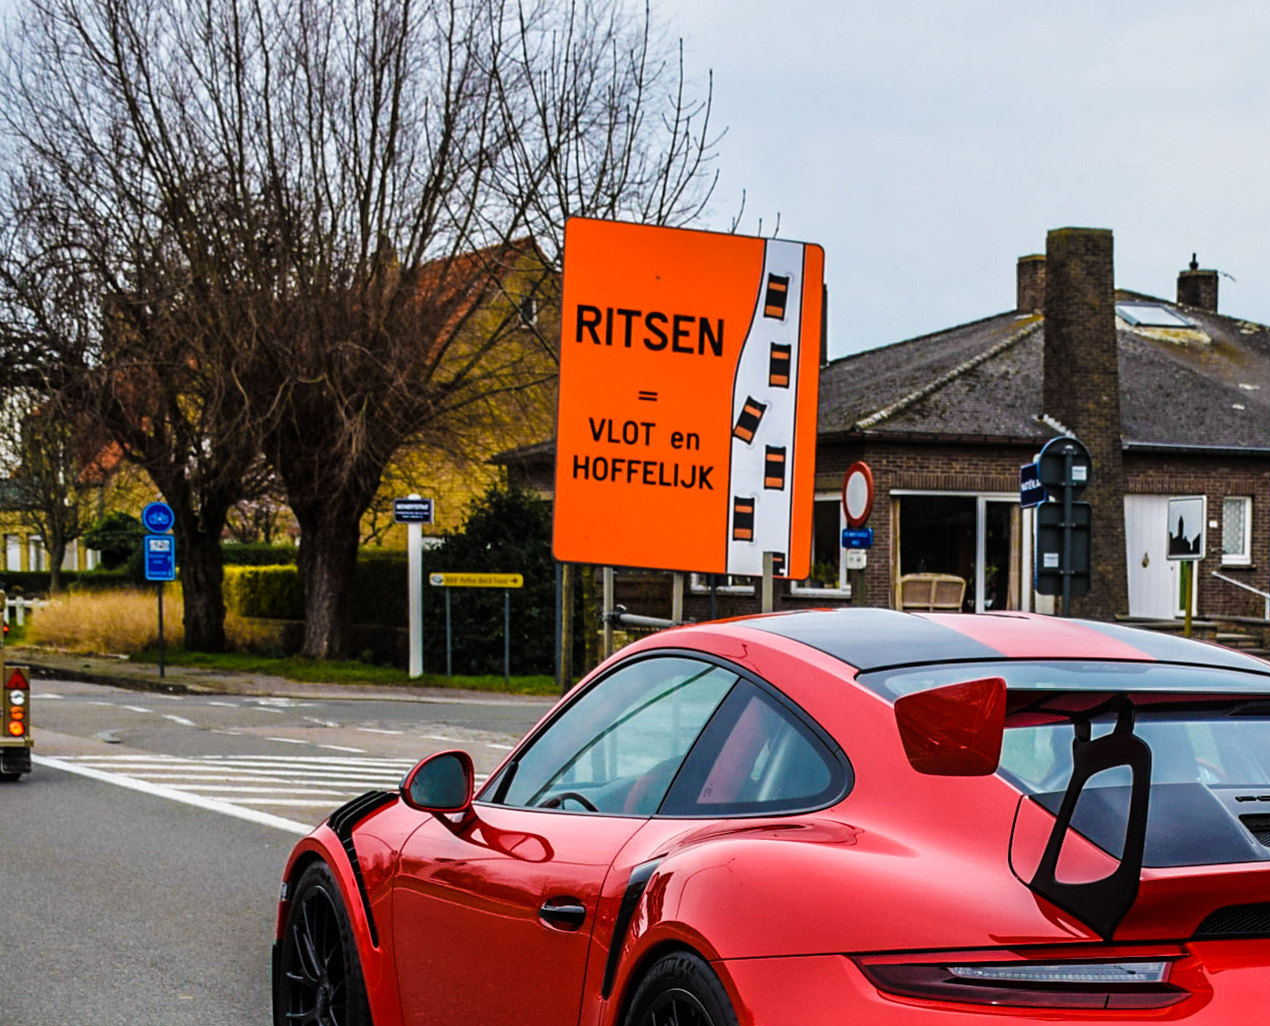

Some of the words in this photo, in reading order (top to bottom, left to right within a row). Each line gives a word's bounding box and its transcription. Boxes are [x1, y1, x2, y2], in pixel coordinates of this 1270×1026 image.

[577, 305, 723, 356] RITSEN
[589, 418, 655, 446] VLOT
[671, 432, 699, 450] en
[573, 455, 713, 490] HOFFELIJK
